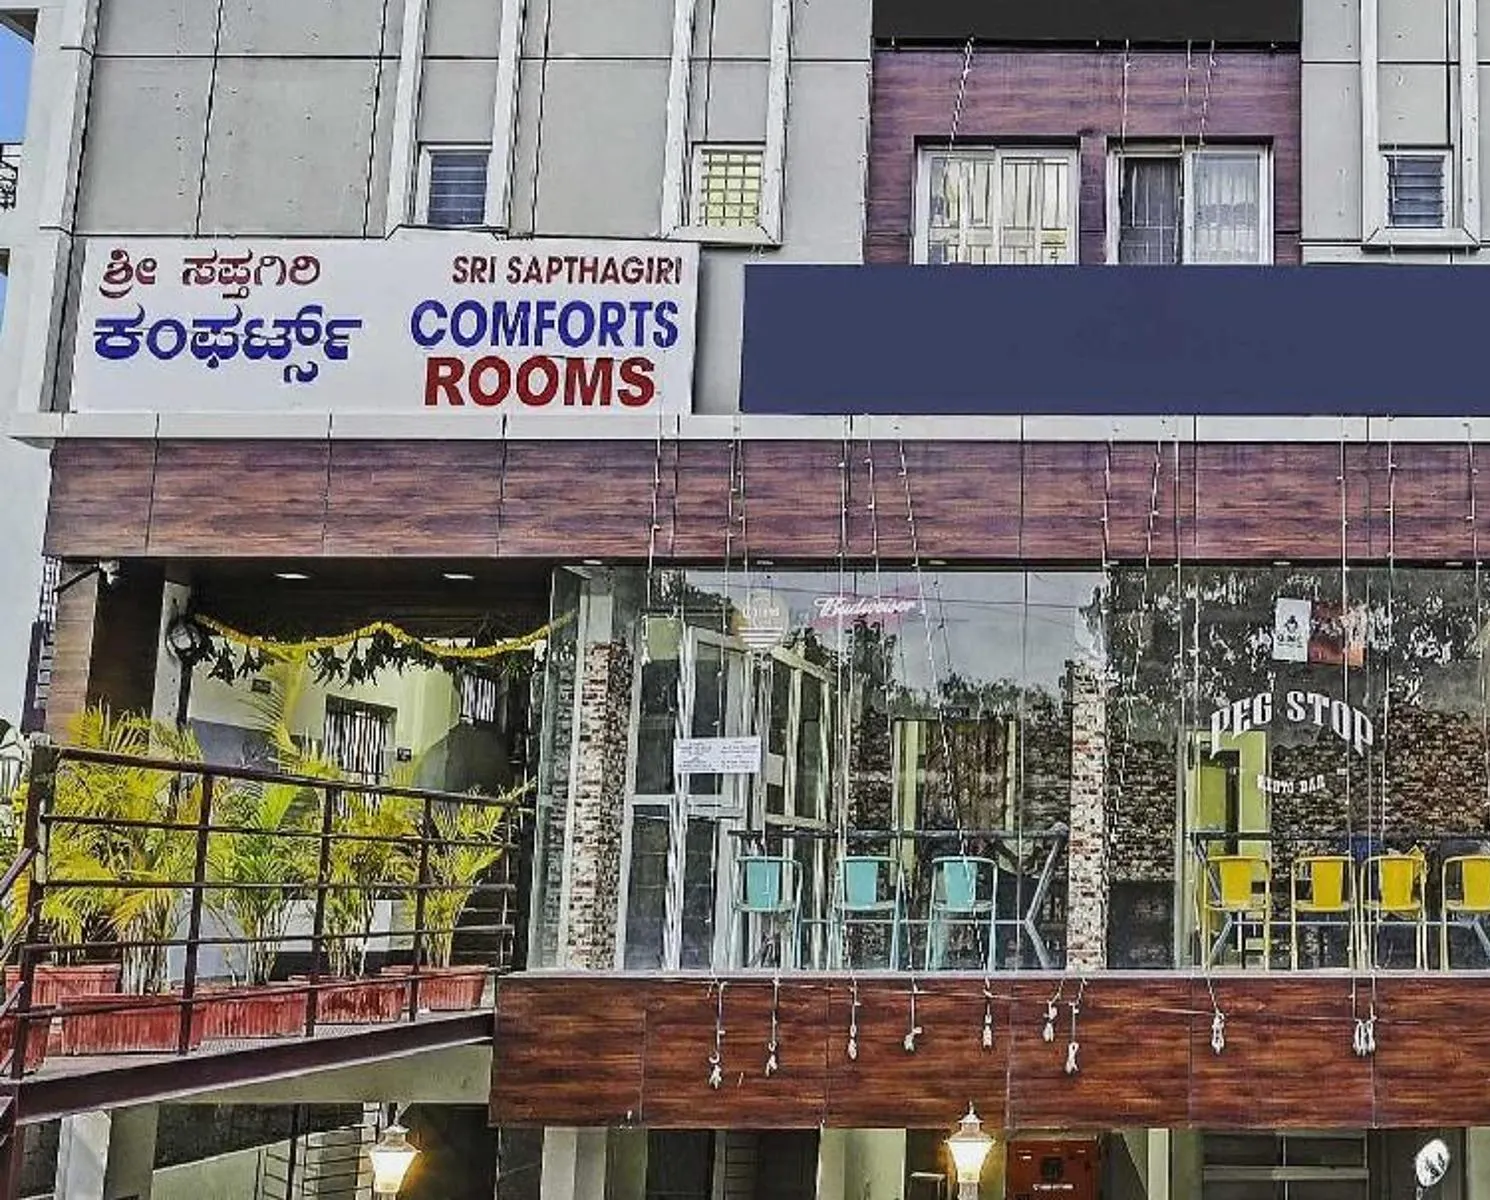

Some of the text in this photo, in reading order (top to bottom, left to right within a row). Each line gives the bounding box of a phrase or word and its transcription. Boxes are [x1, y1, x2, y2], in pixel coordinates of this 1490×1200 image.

[99, 249, 320, 299] ಶ್ರೀ ಸಪ್ತಗಿರಿ
[452, 255, 683, 285] SRI SAPTHAGIRI
[410, 300, 679, 348] COMFORTS
[424, 355, 657, 407] ROOMS
[1210, 690, 1374, 760] PEG STOP
